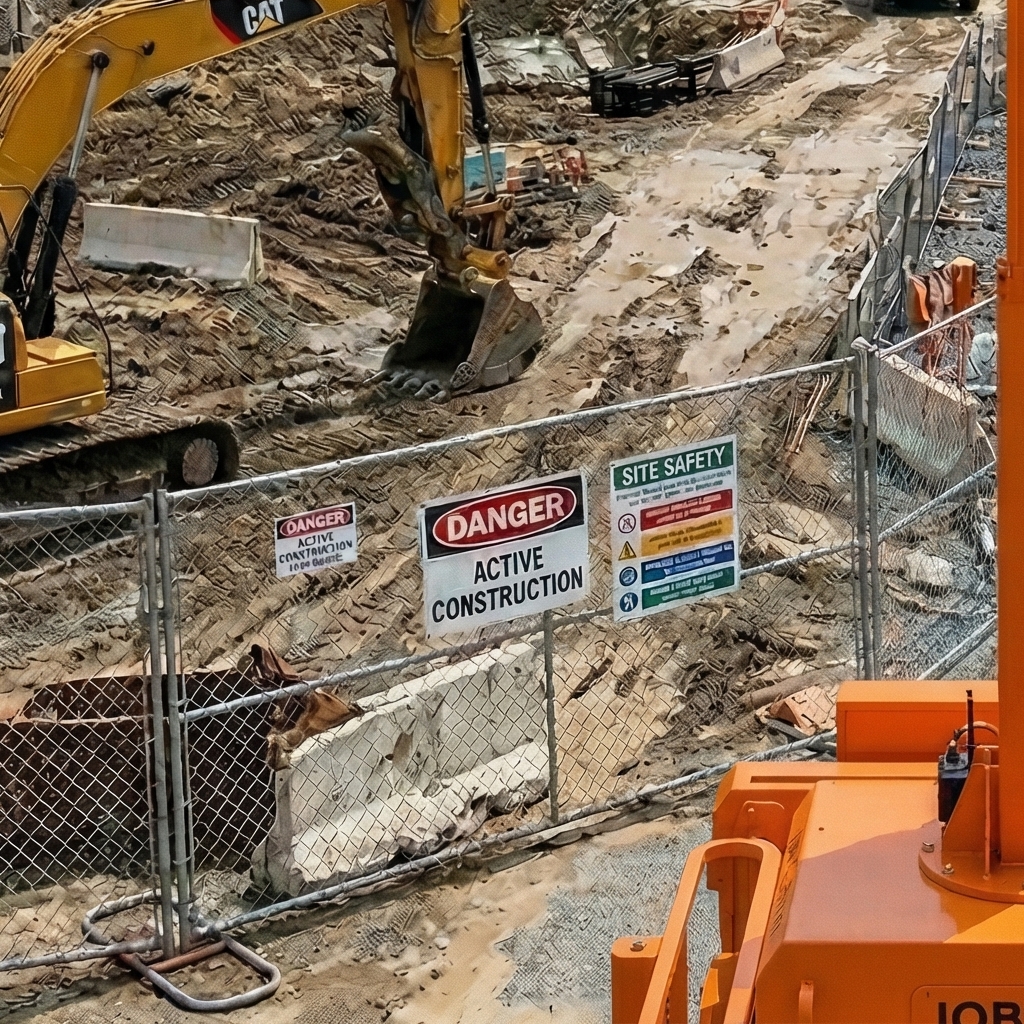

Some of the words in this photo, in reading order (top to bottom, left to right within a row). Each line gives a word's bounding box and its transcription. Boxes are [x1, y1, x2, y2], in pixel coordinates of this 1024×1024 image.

[622, 461, 659, 486] SITE
[664, 446, 726, 476] SAFETY
[447, 492, 565, 542] DANGER
[474, 546, 544, 584] ACTIVE
[432, 566, 583, 623] CONSTRUCTION
